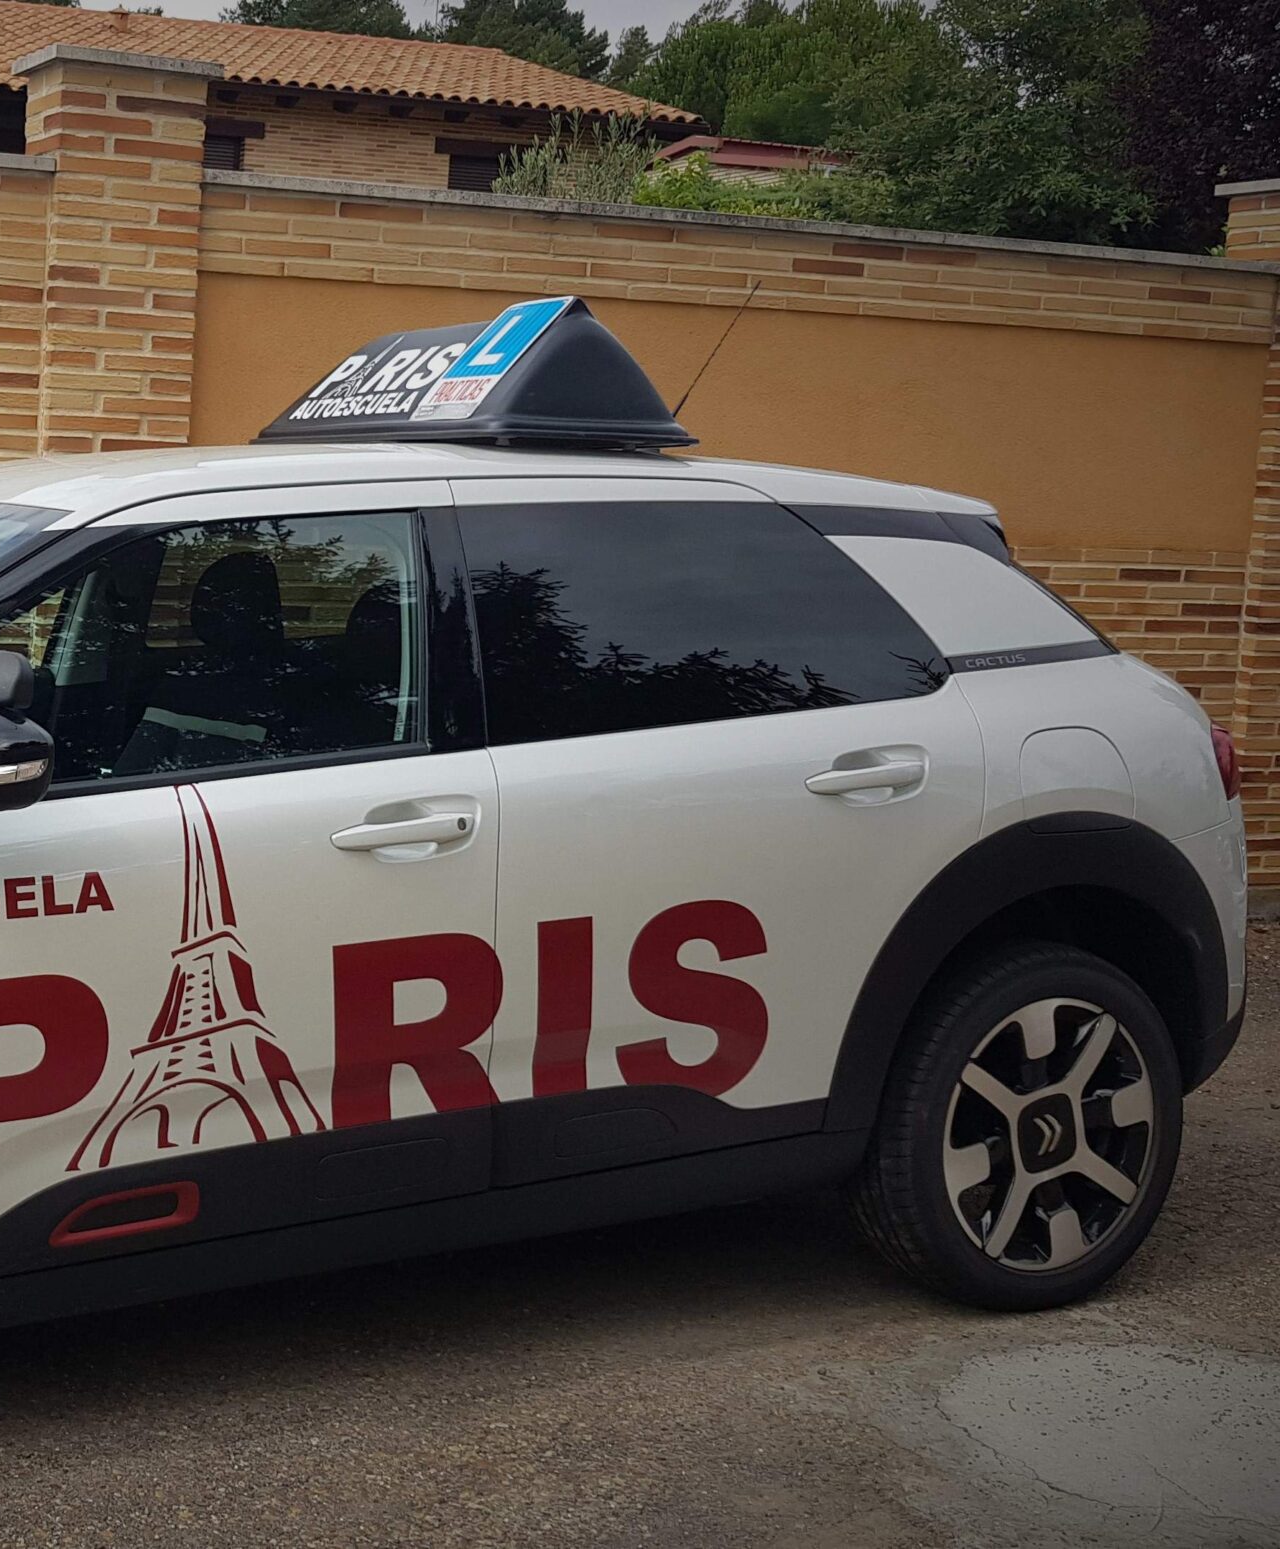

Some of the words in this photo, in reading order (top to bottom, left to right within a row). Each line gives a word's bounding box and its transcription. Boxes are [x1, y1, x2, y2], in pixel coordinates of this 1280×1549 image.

[467, 314, 524, 367] L
[289, 391, 418, 420] AUTOESCUELA
[964, 653, 1026, 669] CACTUS
